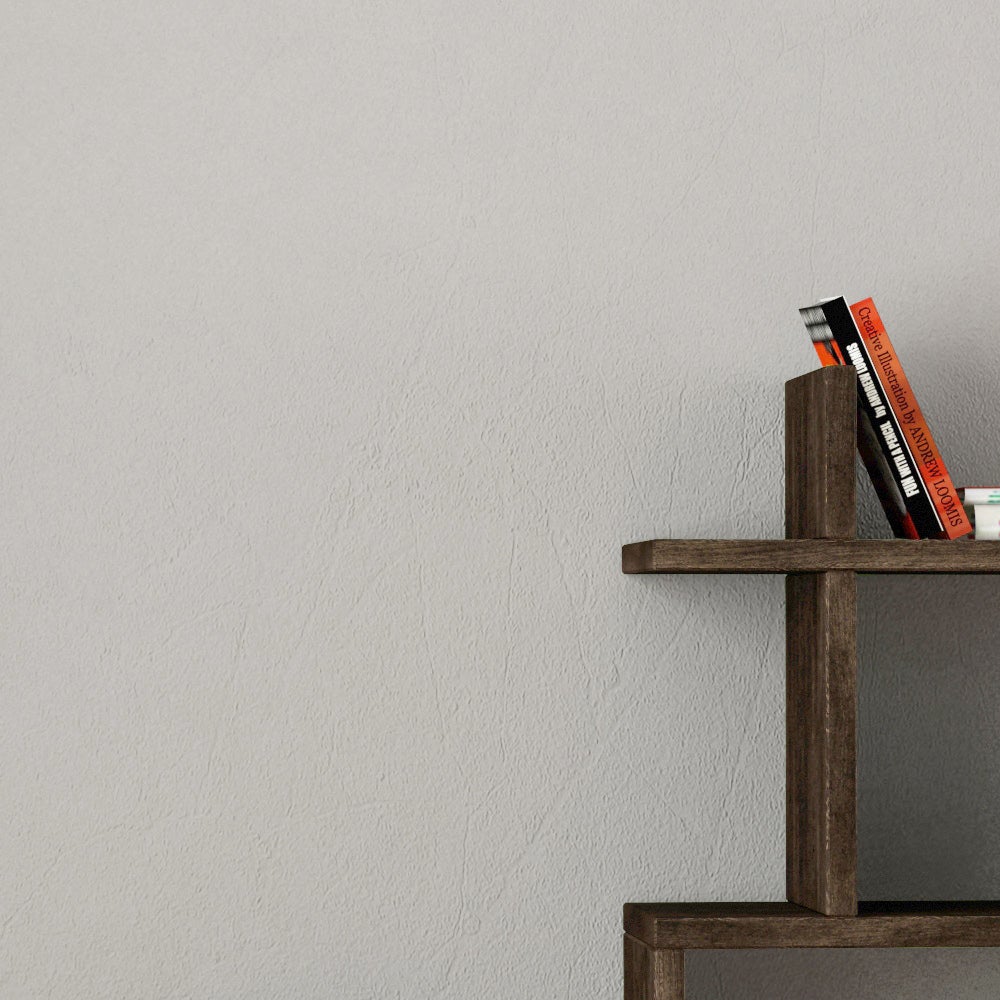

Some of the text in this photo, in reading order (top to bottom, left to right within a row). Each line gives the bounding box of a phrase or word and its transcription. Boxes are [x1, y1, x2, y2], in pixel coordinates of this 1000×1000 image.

[846, 342, 920, 498] FUN WITH A PENCIL by ANDREW LOOMIS
[858, 306, 963, 527] Creative Illustration by ANDREW LOOMIS
